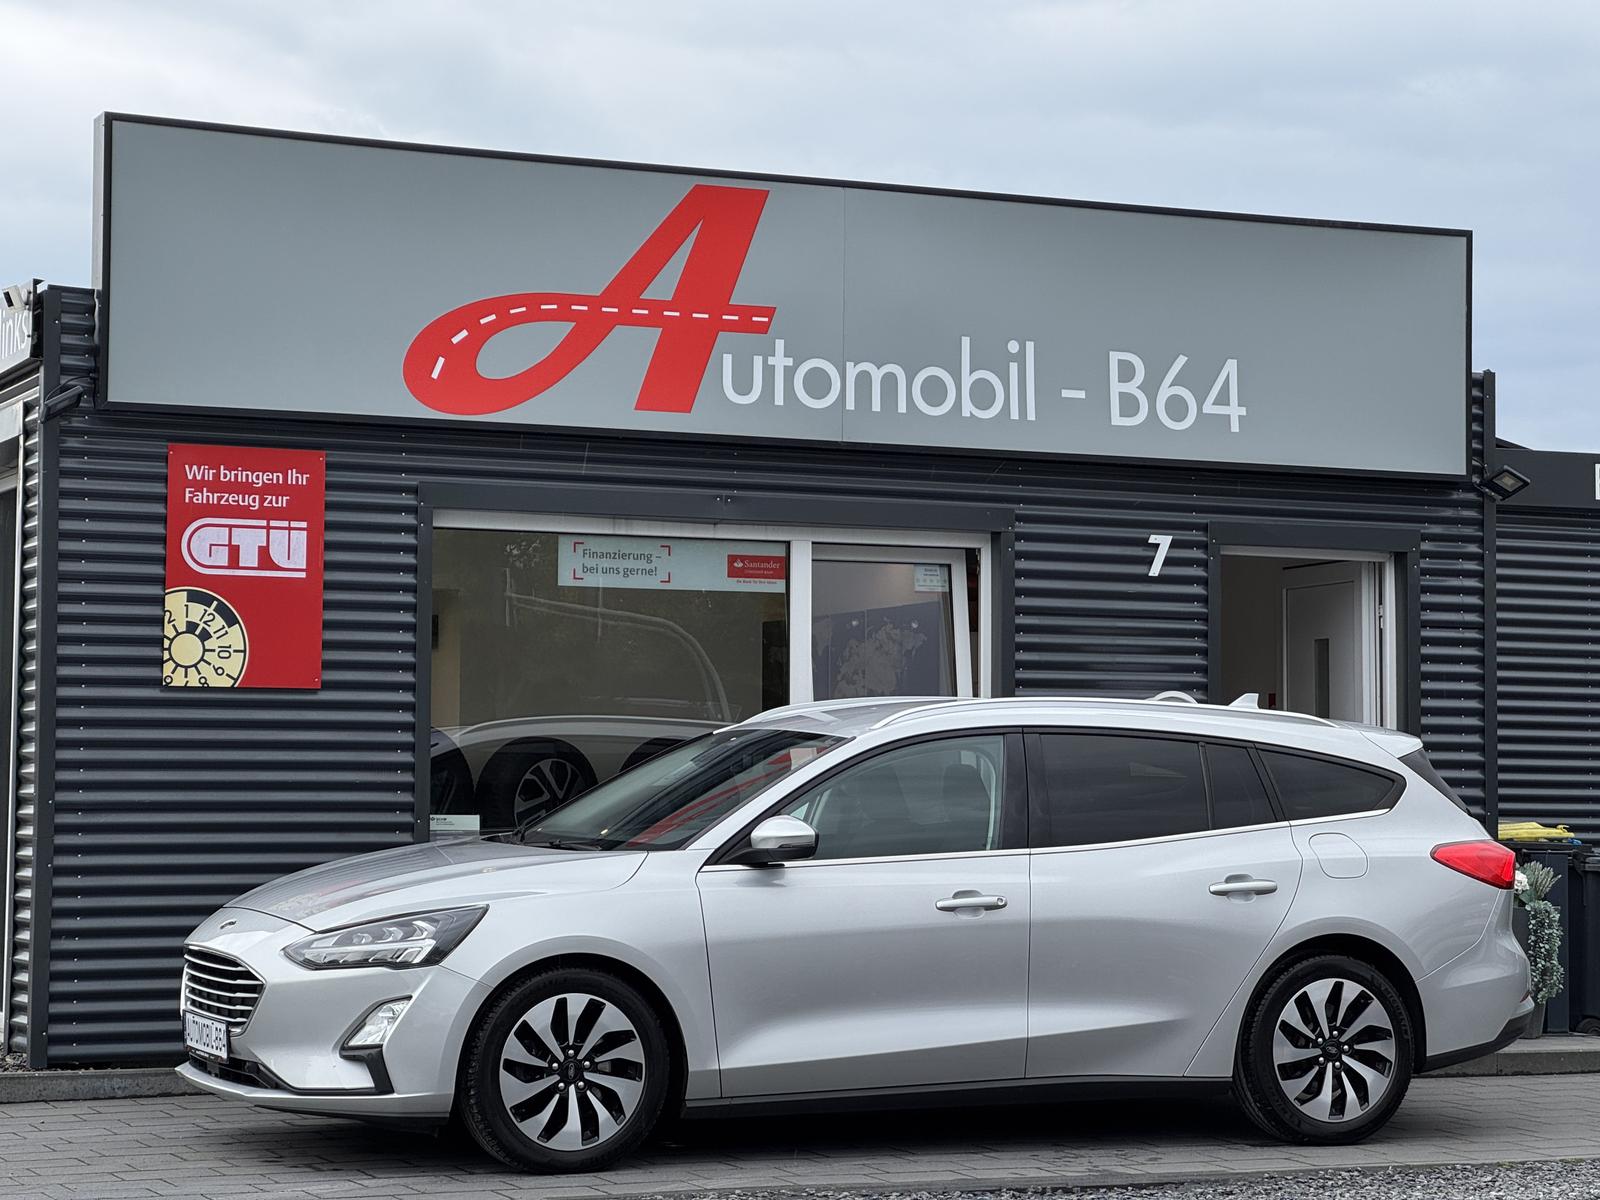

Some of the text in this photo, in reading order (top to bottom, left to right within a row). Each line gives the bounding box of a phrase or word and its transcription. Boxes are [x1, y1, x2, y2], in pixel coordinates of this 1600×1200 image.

[402, 184, 1036, 420] Automobil
[1108, 350, 1247, 433] B64
[184, 464, 310, 487] Wir bringen Ihr
[184, 488, 290, 510] Fahrzeug zur
[184, 519, 308, 573] GTÜ
[582, 548, 653, 564] Finanzierung
[744, 559, 781, 569] Santander
[1148, 535, 1173, 576] 7
[582, 563, 658, 578] bei uns gerne!
[184, 604, 189, 618] 1
[199, 608, 216, 627] 12
[213, 624, 229, 640] 11
[217, 643, 232, 660] 10
